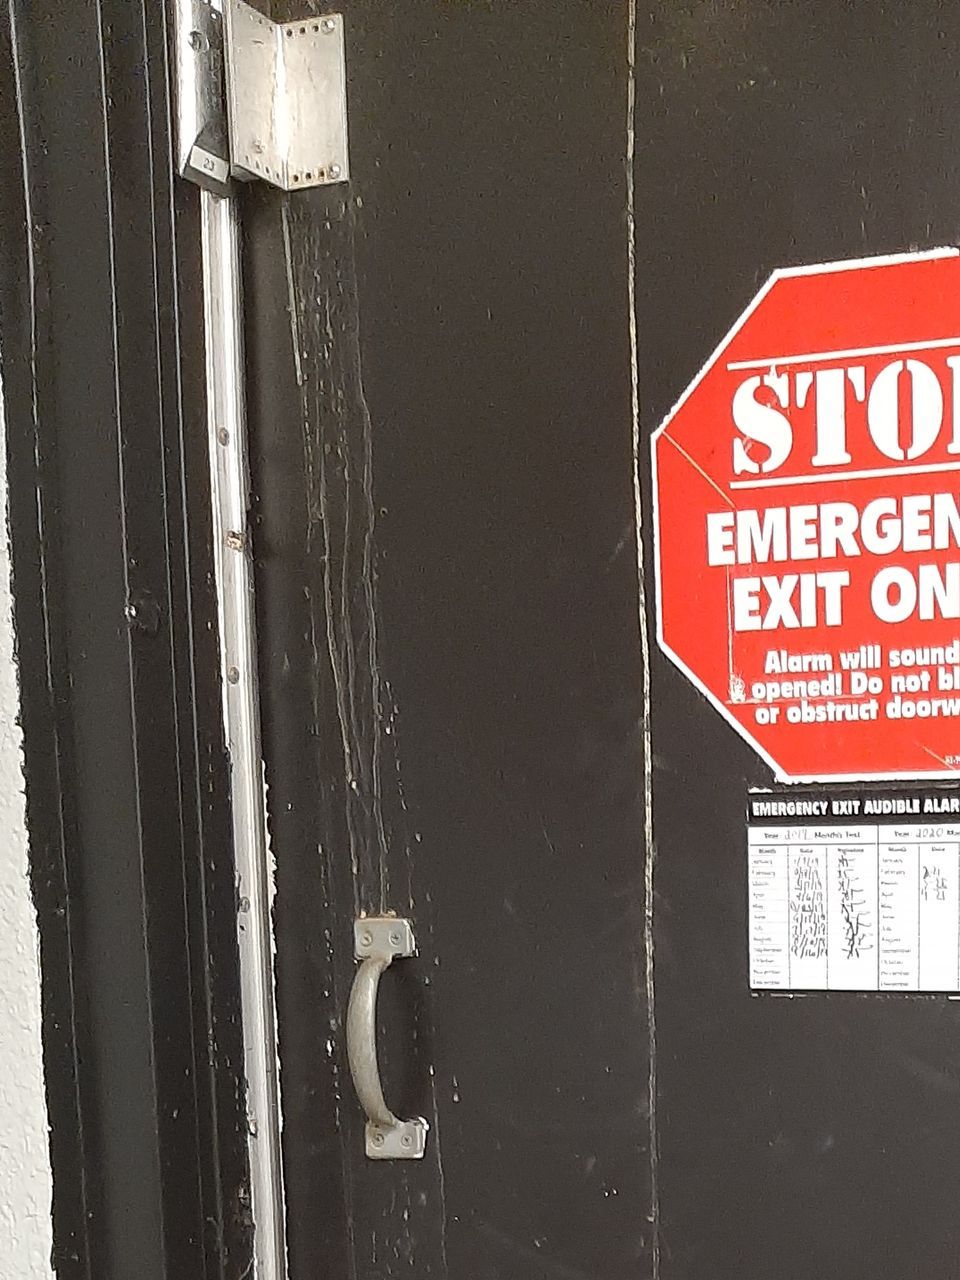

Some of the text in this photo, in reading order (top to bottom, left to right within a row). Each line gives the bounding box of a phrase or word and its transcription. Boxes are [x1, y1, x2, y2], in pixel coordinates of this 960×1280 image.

[733, 570, 850, 632] EXIT
[764, 649, 833, 674] Alarm
[839, 644, 882, 670] will
[888, 639, 960, 667] sound
[751, 672, 843, 702] opened!
[850, 671, 883, 695] Do
[891, 670, 931, 693] not
[755, 706, 780, 725] or
[786, 698, 879, 724] obstruct
[752, 800, 829, 817] EMERGENCY
[831, 799, 861, 815] EXIT
[863, 799, 920, 815] AUDIBLE
